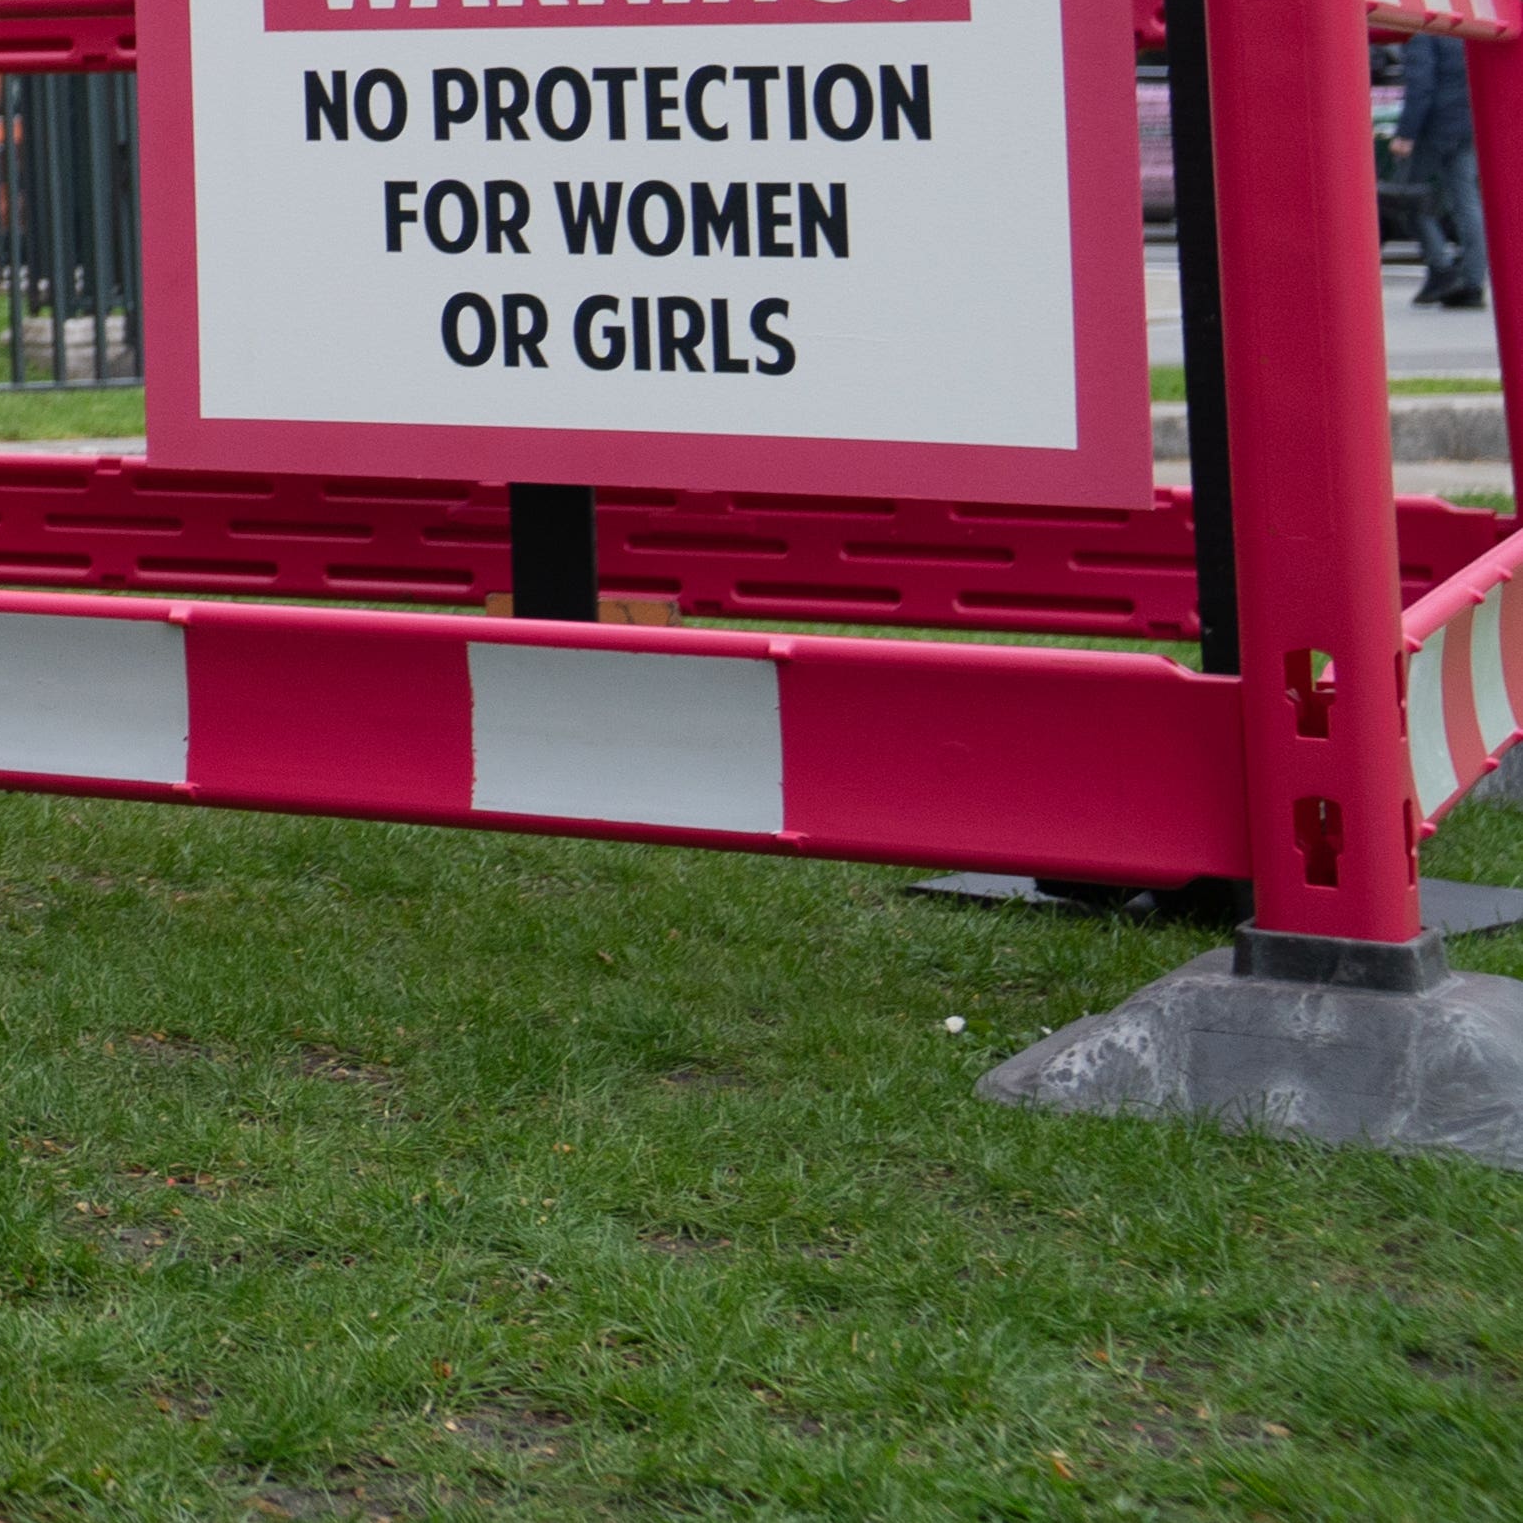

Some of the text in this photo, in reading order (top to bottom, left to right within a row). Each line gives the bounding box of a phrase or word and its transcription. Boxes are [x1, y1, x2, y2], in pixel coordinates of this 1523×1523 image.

[303, 62, 933, 144] NO PROTECTION
[383, 178, 851, 260] FOR WOMEN
[440, 291, 797, 377] OR GIRLS
